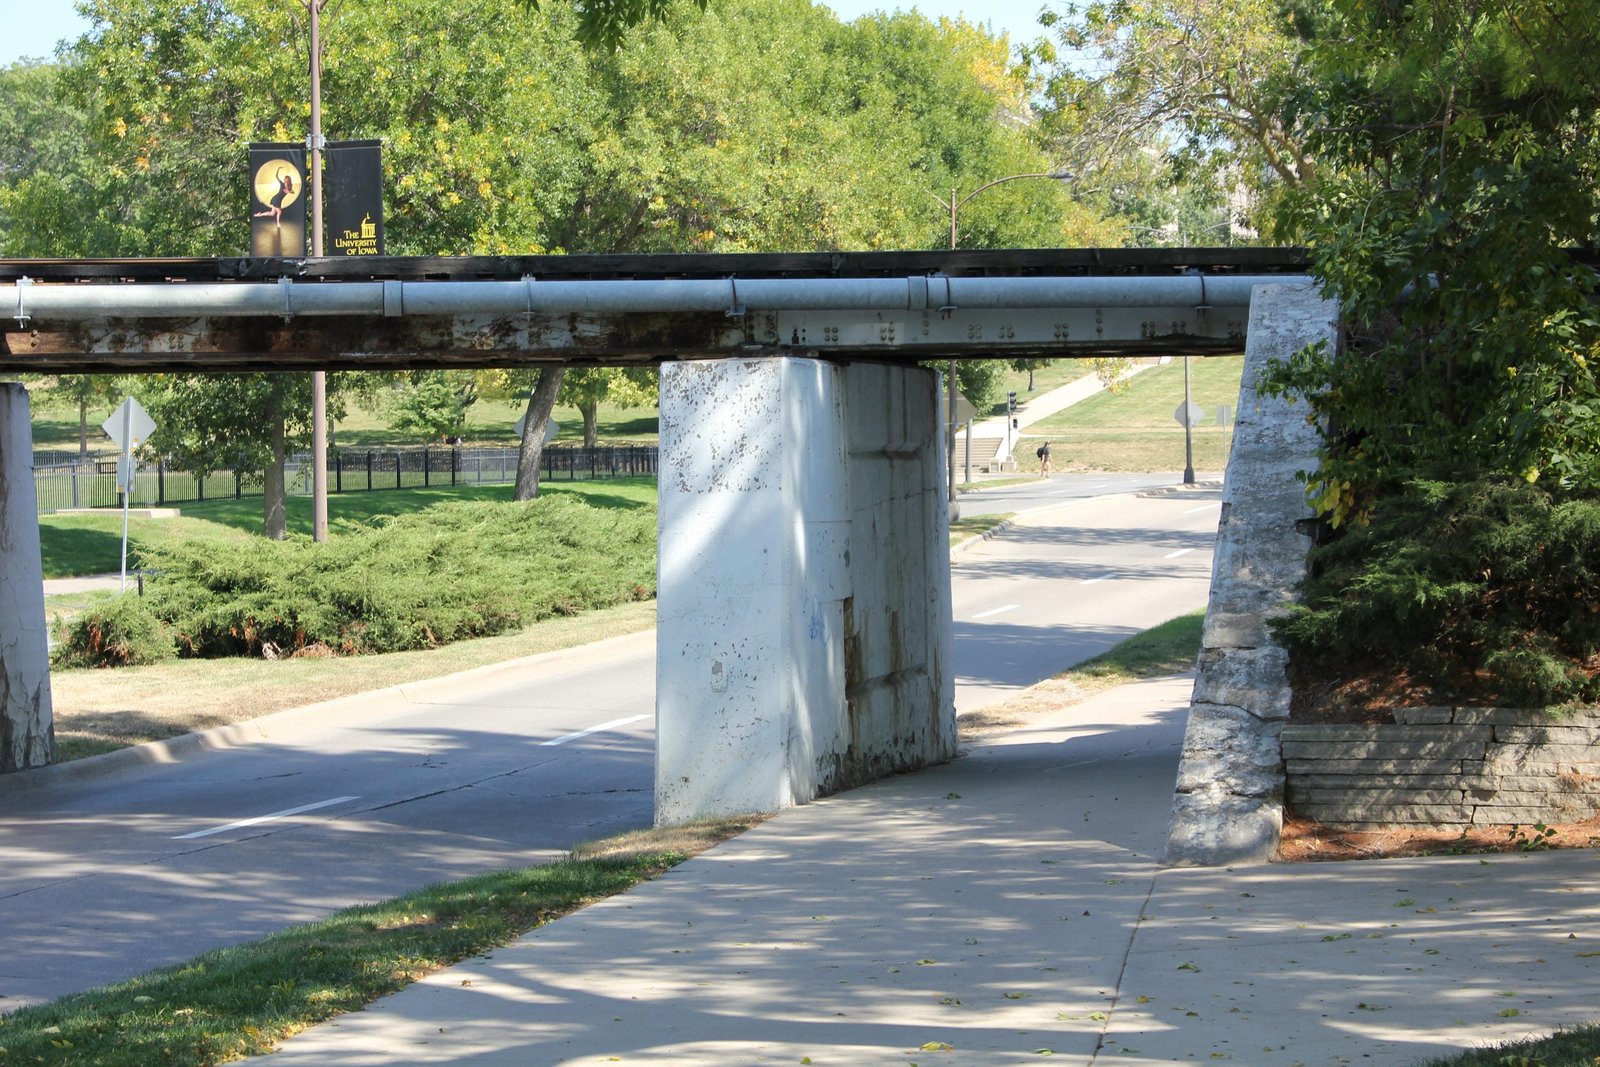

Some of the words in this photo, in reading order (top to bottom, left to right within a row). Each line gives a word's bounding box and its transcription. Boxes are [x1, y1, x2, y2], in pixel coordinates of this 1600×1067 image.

[344, 230, 359, 239] THE
[335, 238, 377, 248] UNIVERSITY
[358, 247, 378, 255] IOWA
